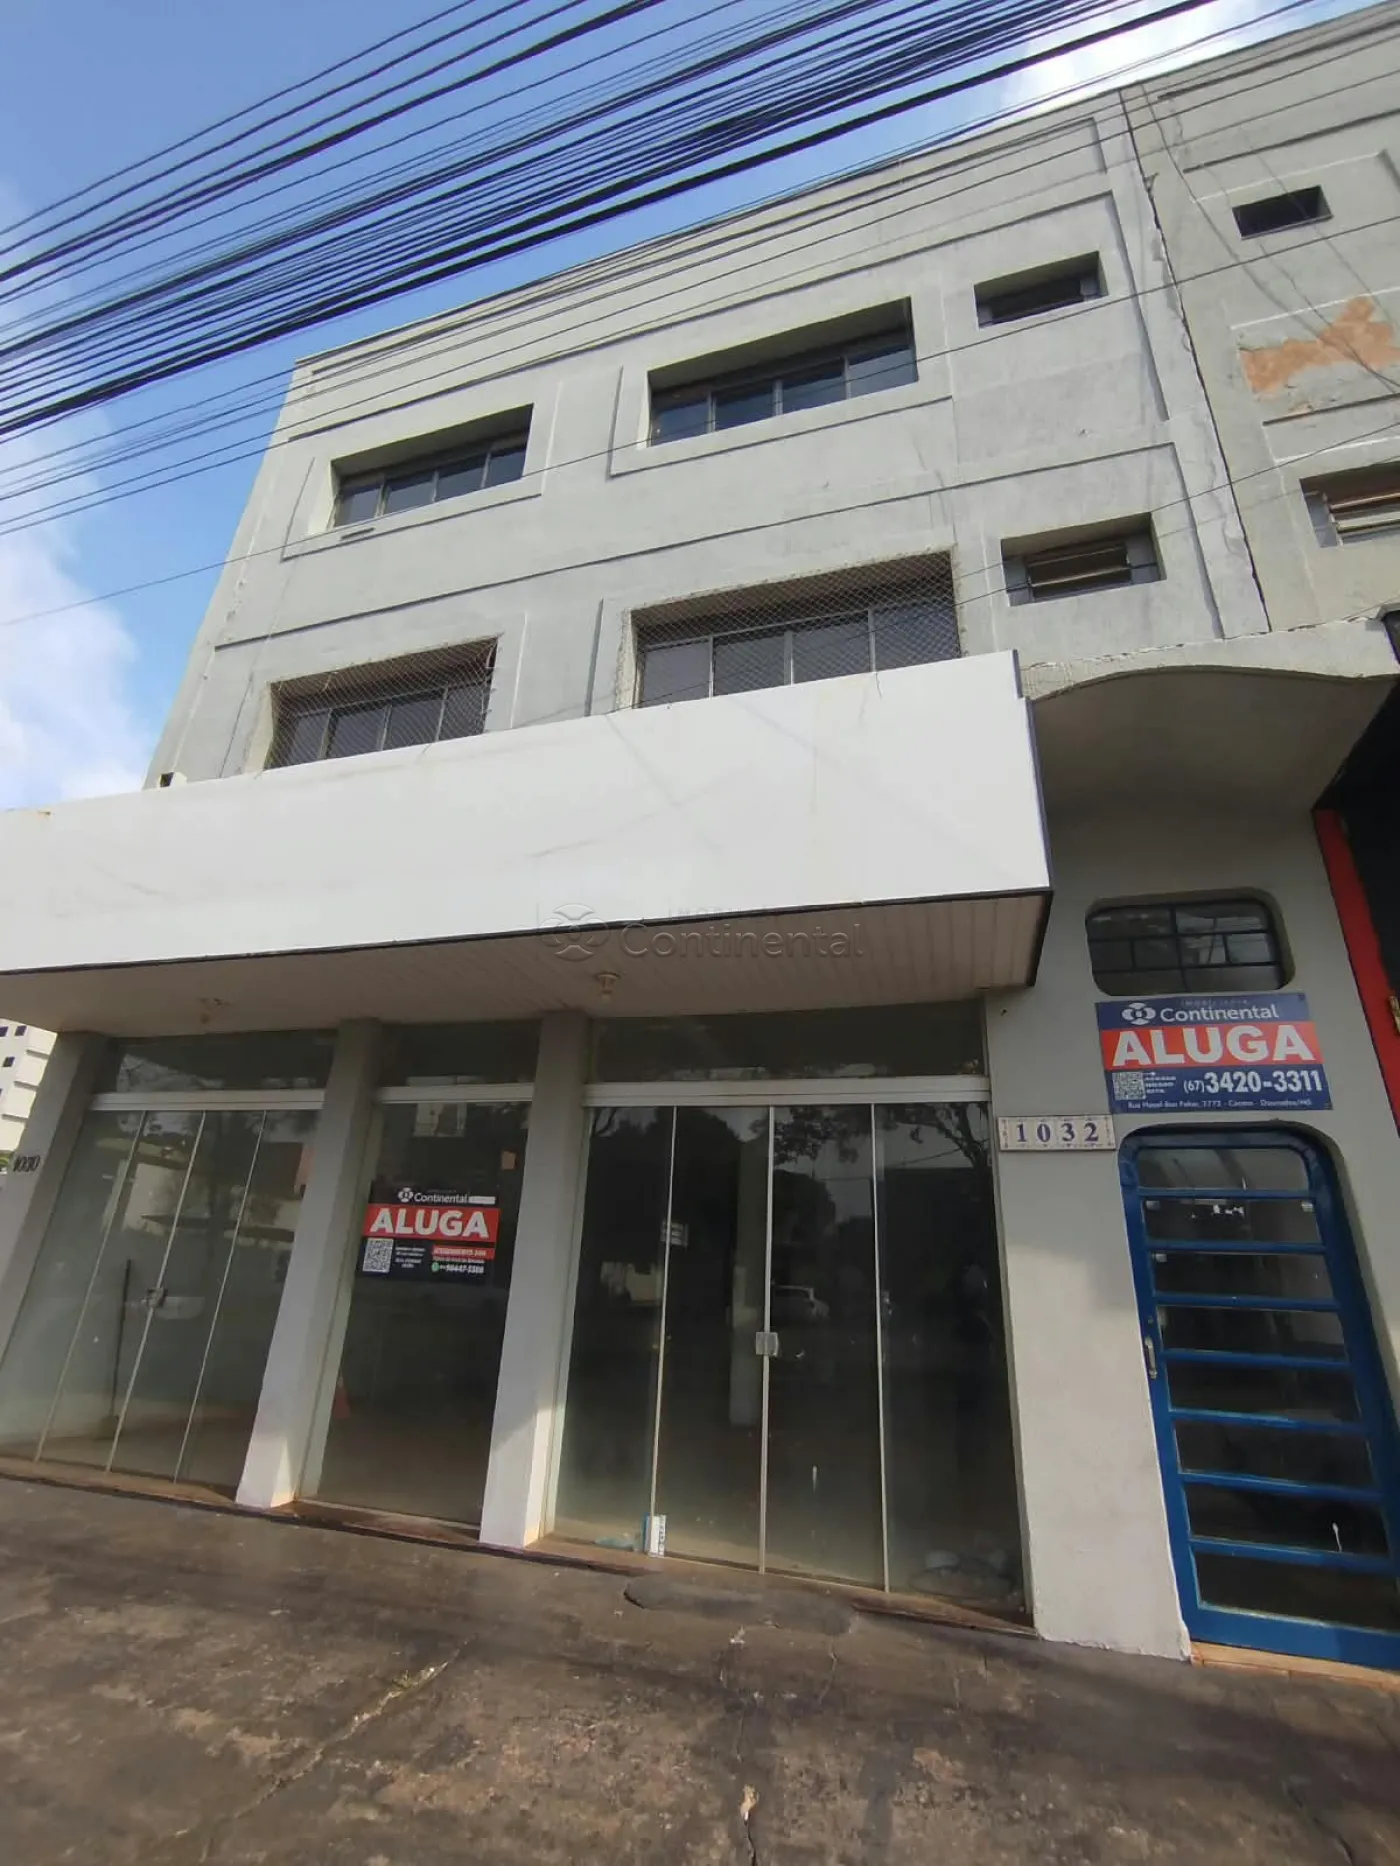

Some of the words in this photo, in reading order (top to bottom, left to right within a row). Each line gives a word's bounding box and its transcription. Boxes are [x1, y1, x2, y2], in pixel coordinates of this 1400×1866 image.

[1160, 1004, 1279, 1023] Continental
[1112, 1024, 1316, 1067] ALUGA
[1183, 1080, 1205, 1094] (67)
[1204, 1070, 1323, 1093] 3420-3311
[1017, 1122, 1099, 1143] 1032
[414, 1192, 468, 1205] Continental
[370, 1207, 489, 1238] ALUGA
